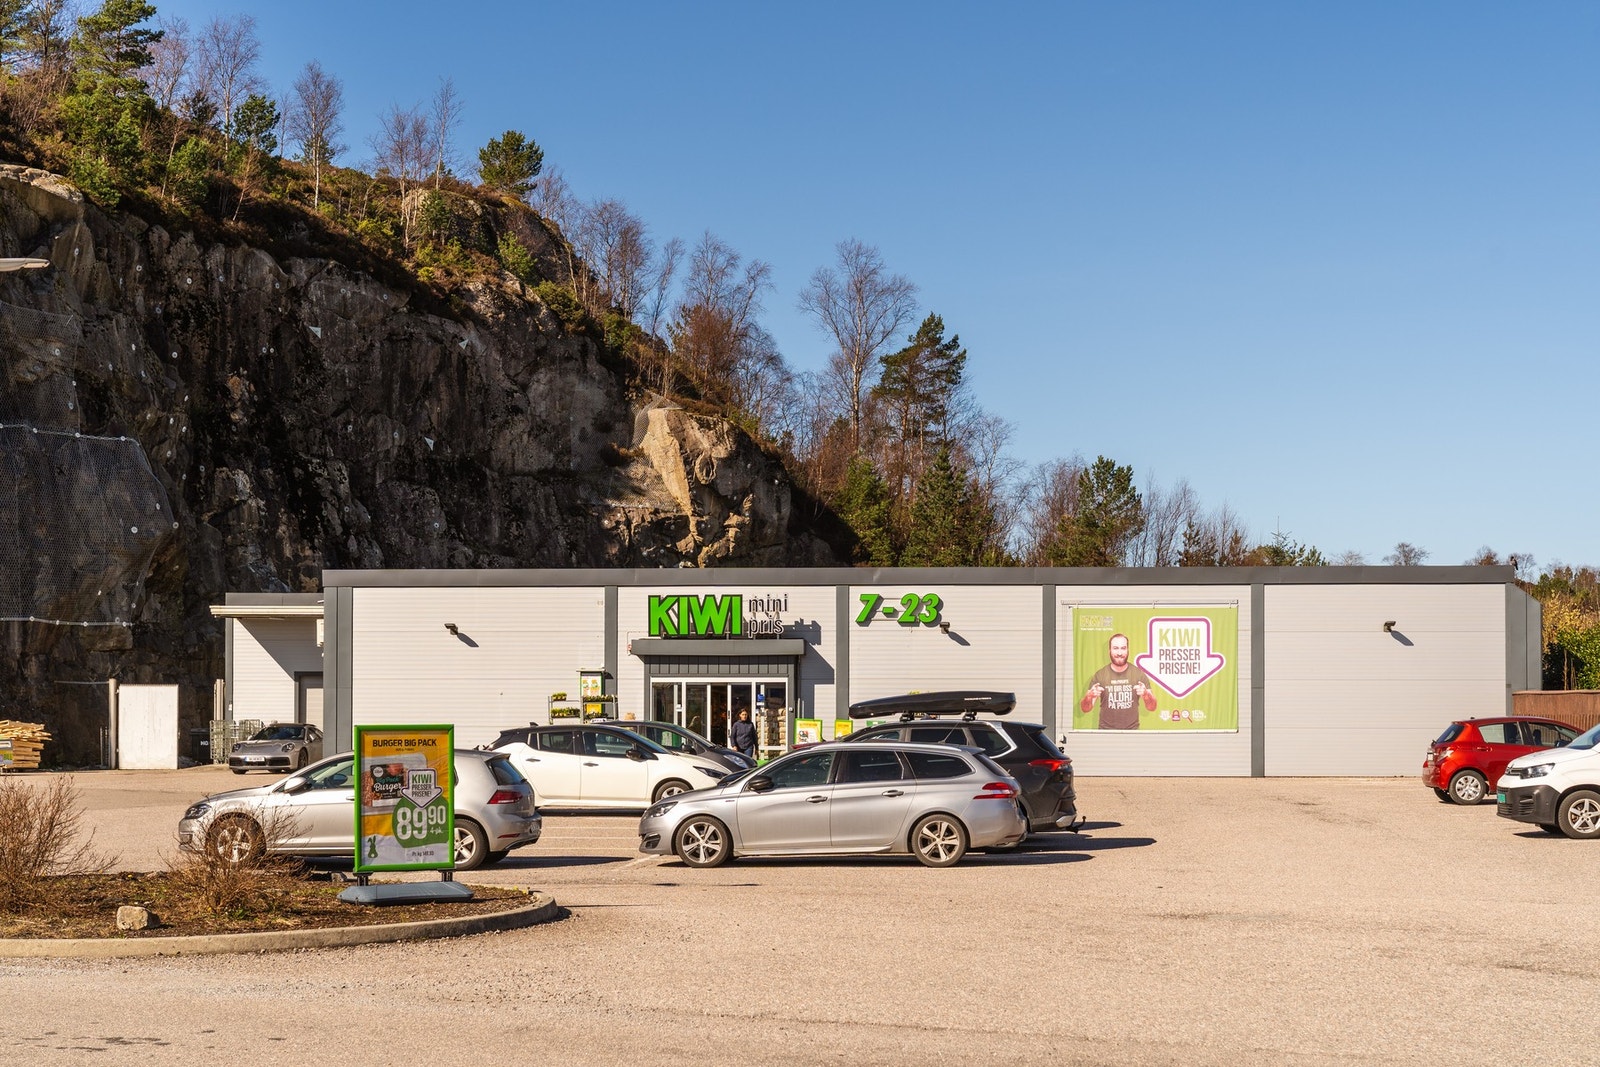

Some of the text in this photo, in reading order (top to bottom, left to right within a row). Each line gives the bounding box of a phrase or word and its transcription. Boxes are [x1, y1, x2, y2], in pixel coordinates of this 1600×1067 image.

[748, 593, 788, 613] mini
[855, 593, 940, 626] 7-23
[648, 594, 743, 637] KIWI
[747, 617, 785, 639] pris
[1159, 628, 1201, 647] KIWI
[1159, 648, 1201, 661] PRESSER
[1159, 662, 1201, 675] PRISENE!
[372, 738, 437, 747] BURGER BIG PACK
[411, 774, 432, 783] KIWI
[373, 783, 402, 792] Burger
